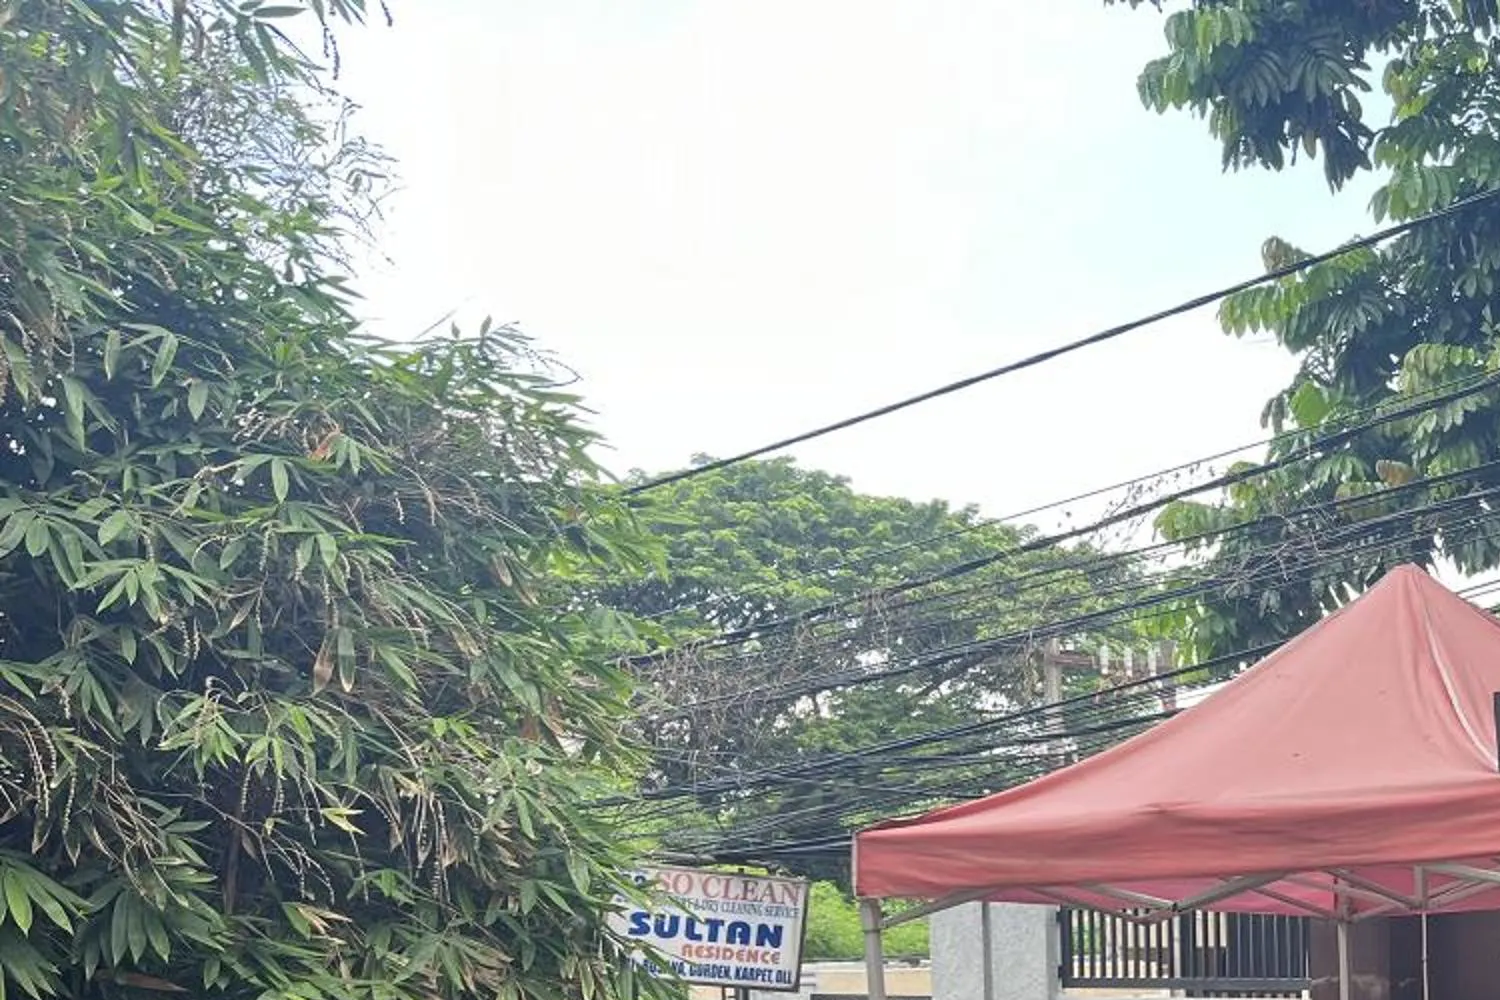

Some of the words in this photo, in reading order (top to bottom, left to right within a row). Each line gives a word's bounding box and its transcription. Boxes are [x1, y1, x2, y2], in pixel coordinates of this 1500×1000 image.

[701, 876, 799, 905] CLEAN
[628, 911, 782, 948] SULTAN
[681, 944, 780, 965] RESIDENCE
